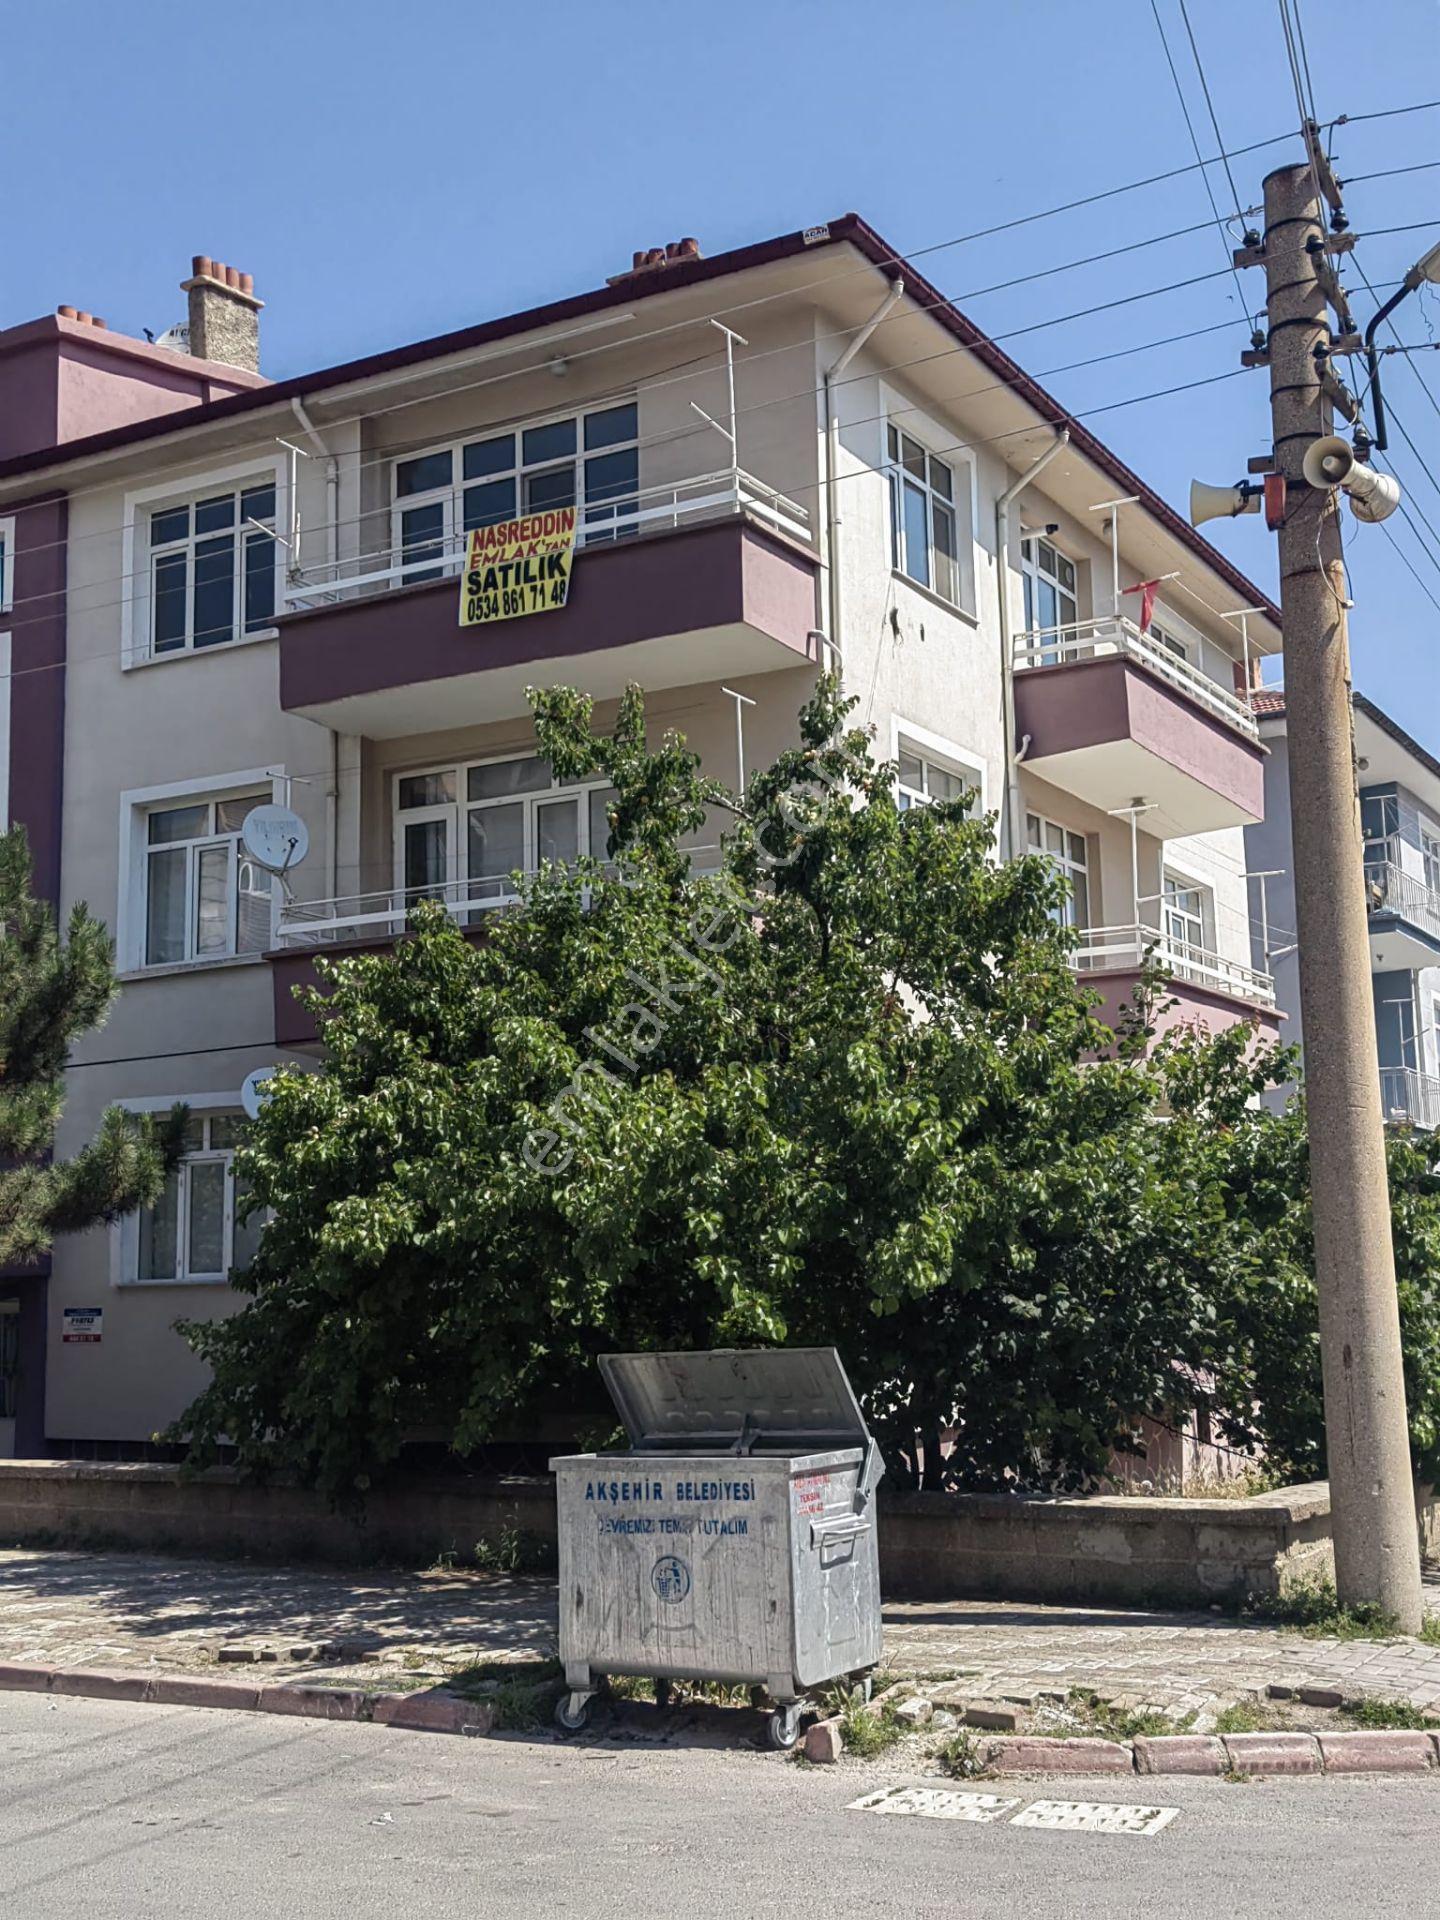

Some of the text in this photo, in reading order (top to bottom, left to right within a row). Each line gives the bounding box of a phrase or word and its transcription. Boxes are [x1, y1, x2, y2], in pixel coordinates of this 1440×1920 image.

[472, 508, 575, 552] NASREDDİN
[467, 552, 567, 596] SATILIK
[470, 538, 571, 571] EMLAK'TAN
[467, 580, 566, 622] 0534 861 71 48
[585, 1478, 756, 1506] AKŞEHİR BELEDİYESİ
